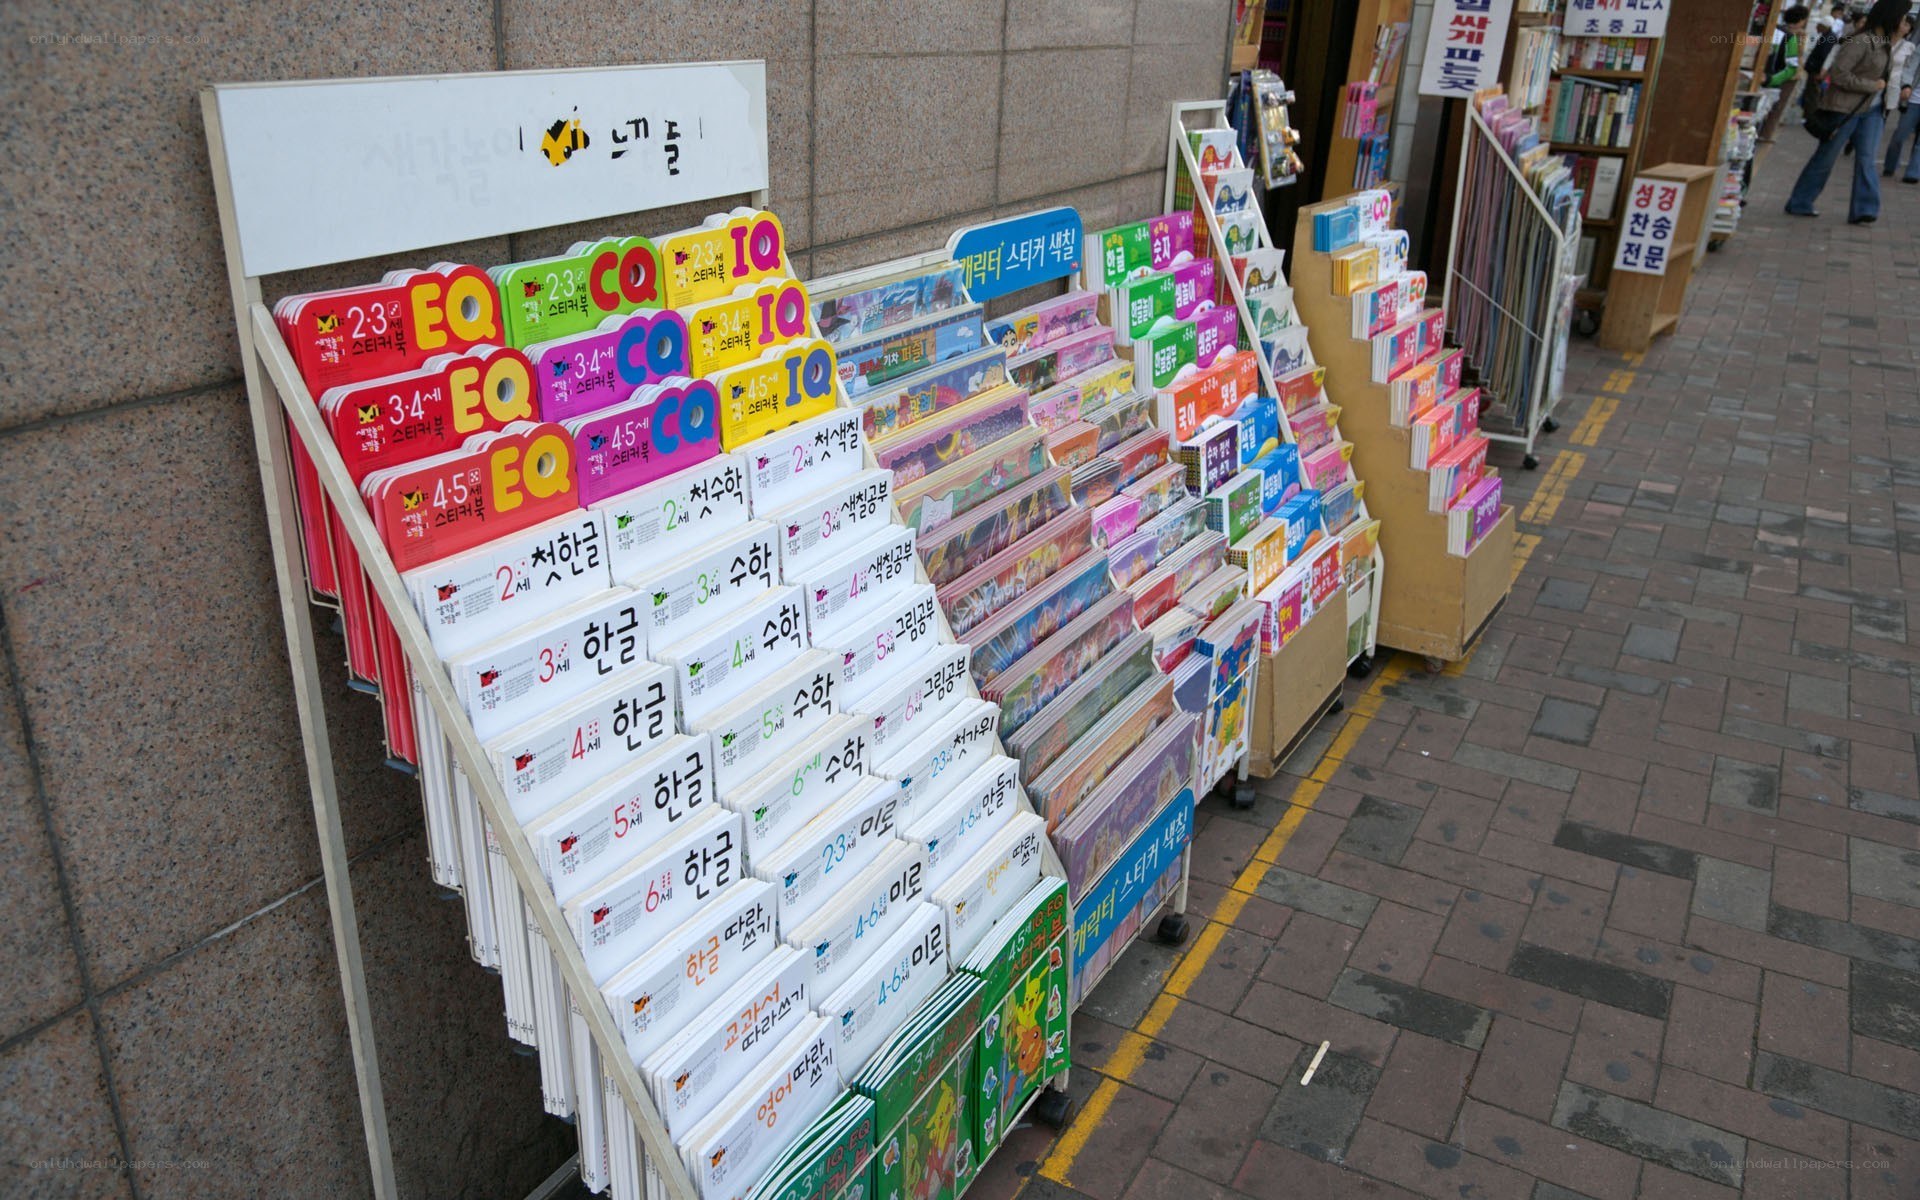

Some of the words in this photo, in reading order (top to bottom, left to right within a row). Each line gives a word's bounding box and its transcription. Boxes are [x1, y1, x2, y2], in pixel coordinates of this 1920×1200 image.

[1585, 19, 1599, 33] 초
[1609, 19, 1623, 33] 중
[1632, 19, 1647, 34] 고
[1635, 184, 1677, 211] 성경
[731, 220, 781, 278] IQ
[1153, 236, 1171, 263] 숫자
[1630, 212, 1671, 240] 찬송
[590, 246, 657, 311] CQ
[960, 247, 1001, 289] 캐릭터
[1006, 235, 1045, 270] 스티커
[1049, 228, 1075, 262] 색칠
[1106, 247, 1125, 276] 한글
[1623, 242, 1664, 269] 전문
[411, 276, 496, 350] EQ
[757, 287, 806, 345] IQ
[617, 320, 684, 385] CQ
[1155, 344, 1176, 376] 한글공부
[449, 357, 532, 434] EQ
[785, 349, 831, 407] IQ
[652, 390, 715, 454] CQ
[814, 417, 859, 463] 첫색칠
[491, 435, 571, 513] EQ
[690, 465, 744, 519] 첫수학
[840, 480, 888, 523] 색칠공부
[531, 520, 599, 587] 첫한글
[729, 541, 773, 590] 수학
[867, 540, 913, 582] 색칠공부
[583, 606, 639, 676] 한글
[762, 603, 801, 650] 수학
[895, 596, 935, 642] 그림공부
[792, 672, 834, 718] 수학
[923, 656, 966, 701] 그림공부
[613, 681, 666, 752] 한글
[953, 716, 995, 760] 첫가위
[825, 735, 865, 784] 수학
[654, 751, 704, 823] 한글
[982, 772, 1016, 817] 만들기
[860, 799, 897, 837] 미로
[684, 829, 733, 901] 한글
[1012, 832, 1035, 859] 따라
[1021, 842, 1040, 867] 쓰기
[1120, 838, 1159, 902] 스티커
[1163, 806, 1188, 850] 색칠
[889, 861, 923, 903] 미로
[686, 935, 720, 986] 한글
[724, 902, 763, 941] 따라
[742, 915, 771, 952] 쓰기
[911, 923, 944, 965] 미로
[723, 982, 780, 1052] 교과서
[741, 983, 804, 1052] 따라쓰기
[757, 1081, 792, 1128] 영어
[793, 1038, 824, 1082] 따라
[810, 1047, 833, 1088] 쓰기
